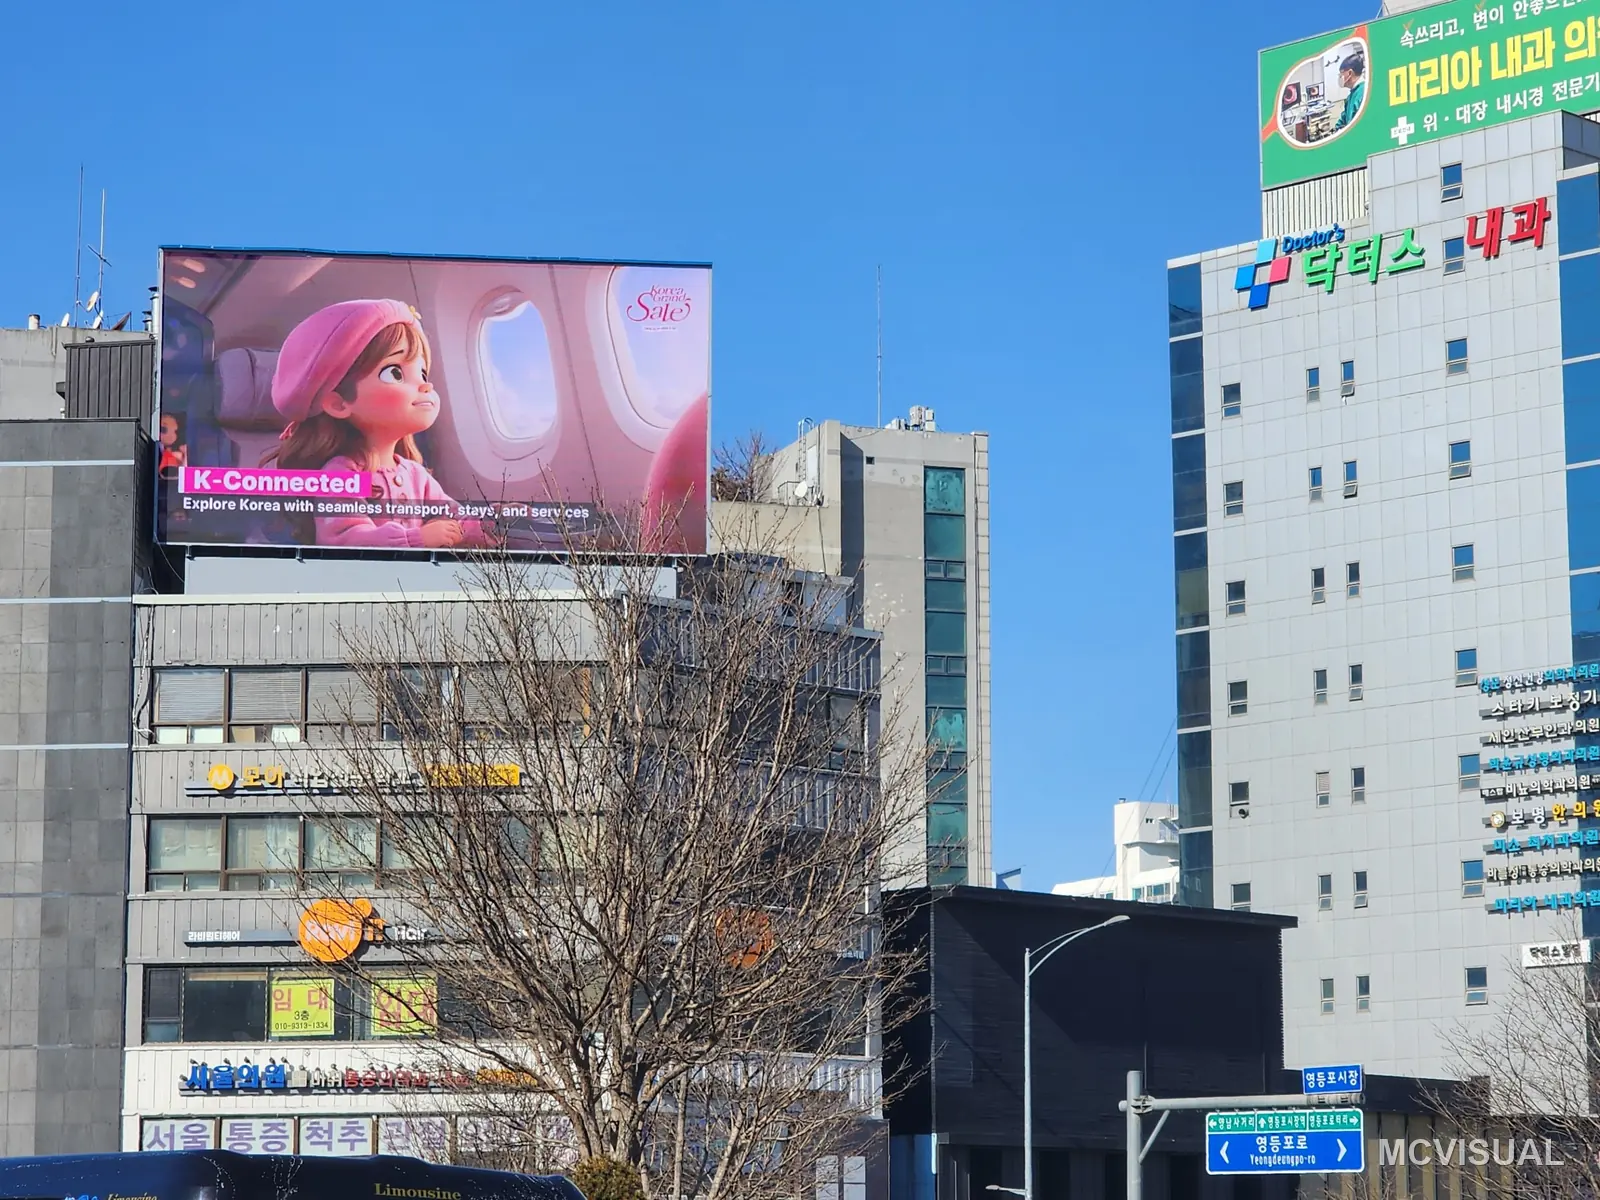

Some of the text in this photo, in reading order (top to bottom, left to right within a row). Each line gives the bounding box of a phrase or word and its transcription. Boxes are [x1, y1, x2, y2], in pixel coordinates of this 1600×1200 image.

[1400, 17, 1465, 48] 속쓰리고,
[1473, 5, 1504, 30] 변이
[1388, 15, 1600, 107] 마리아 내과 의
[1423, 114, 1437, 132] 위
[1456, 101, 1488, 126] 대장
[1496, 86, 1543, 115] 내시경
[1282, 223, 1345, 254] Doctor's
[1302, 197, 1552, 293] 닥터스 내과
[627, 292, 691, 322] Sale
[193, 470, 361, 494] K-Connected
[183, 497, 590, 519] Explore Korea with seamless transport, stays, and servces
[1491, 696, 1541, 716] 스타키
[241, 765, 285, 789] 모아
[1493, 838, 1521, 853] 미소
[274, 1022, 329, 1031] 010-9313-1334
[293, 1009, 310, 1021] 3층
[185, 1063, 286, 1091] 서울의원
[1305, 1070, 1359, 1089] 영등포시장
[1218, 1113, 1349, 1130] 양남사거리 영등포시장역 영등포로터리
[225, 1121, 290, 1156] 통증
[304, 1120, 369, 1153] 척추
[1255, 1135, 1309, 1154] 영등포로
[1250, 1154, 1317, 1168] Yeongdeungpo-ro
[374, 1183, 462, 1200] Limousine
